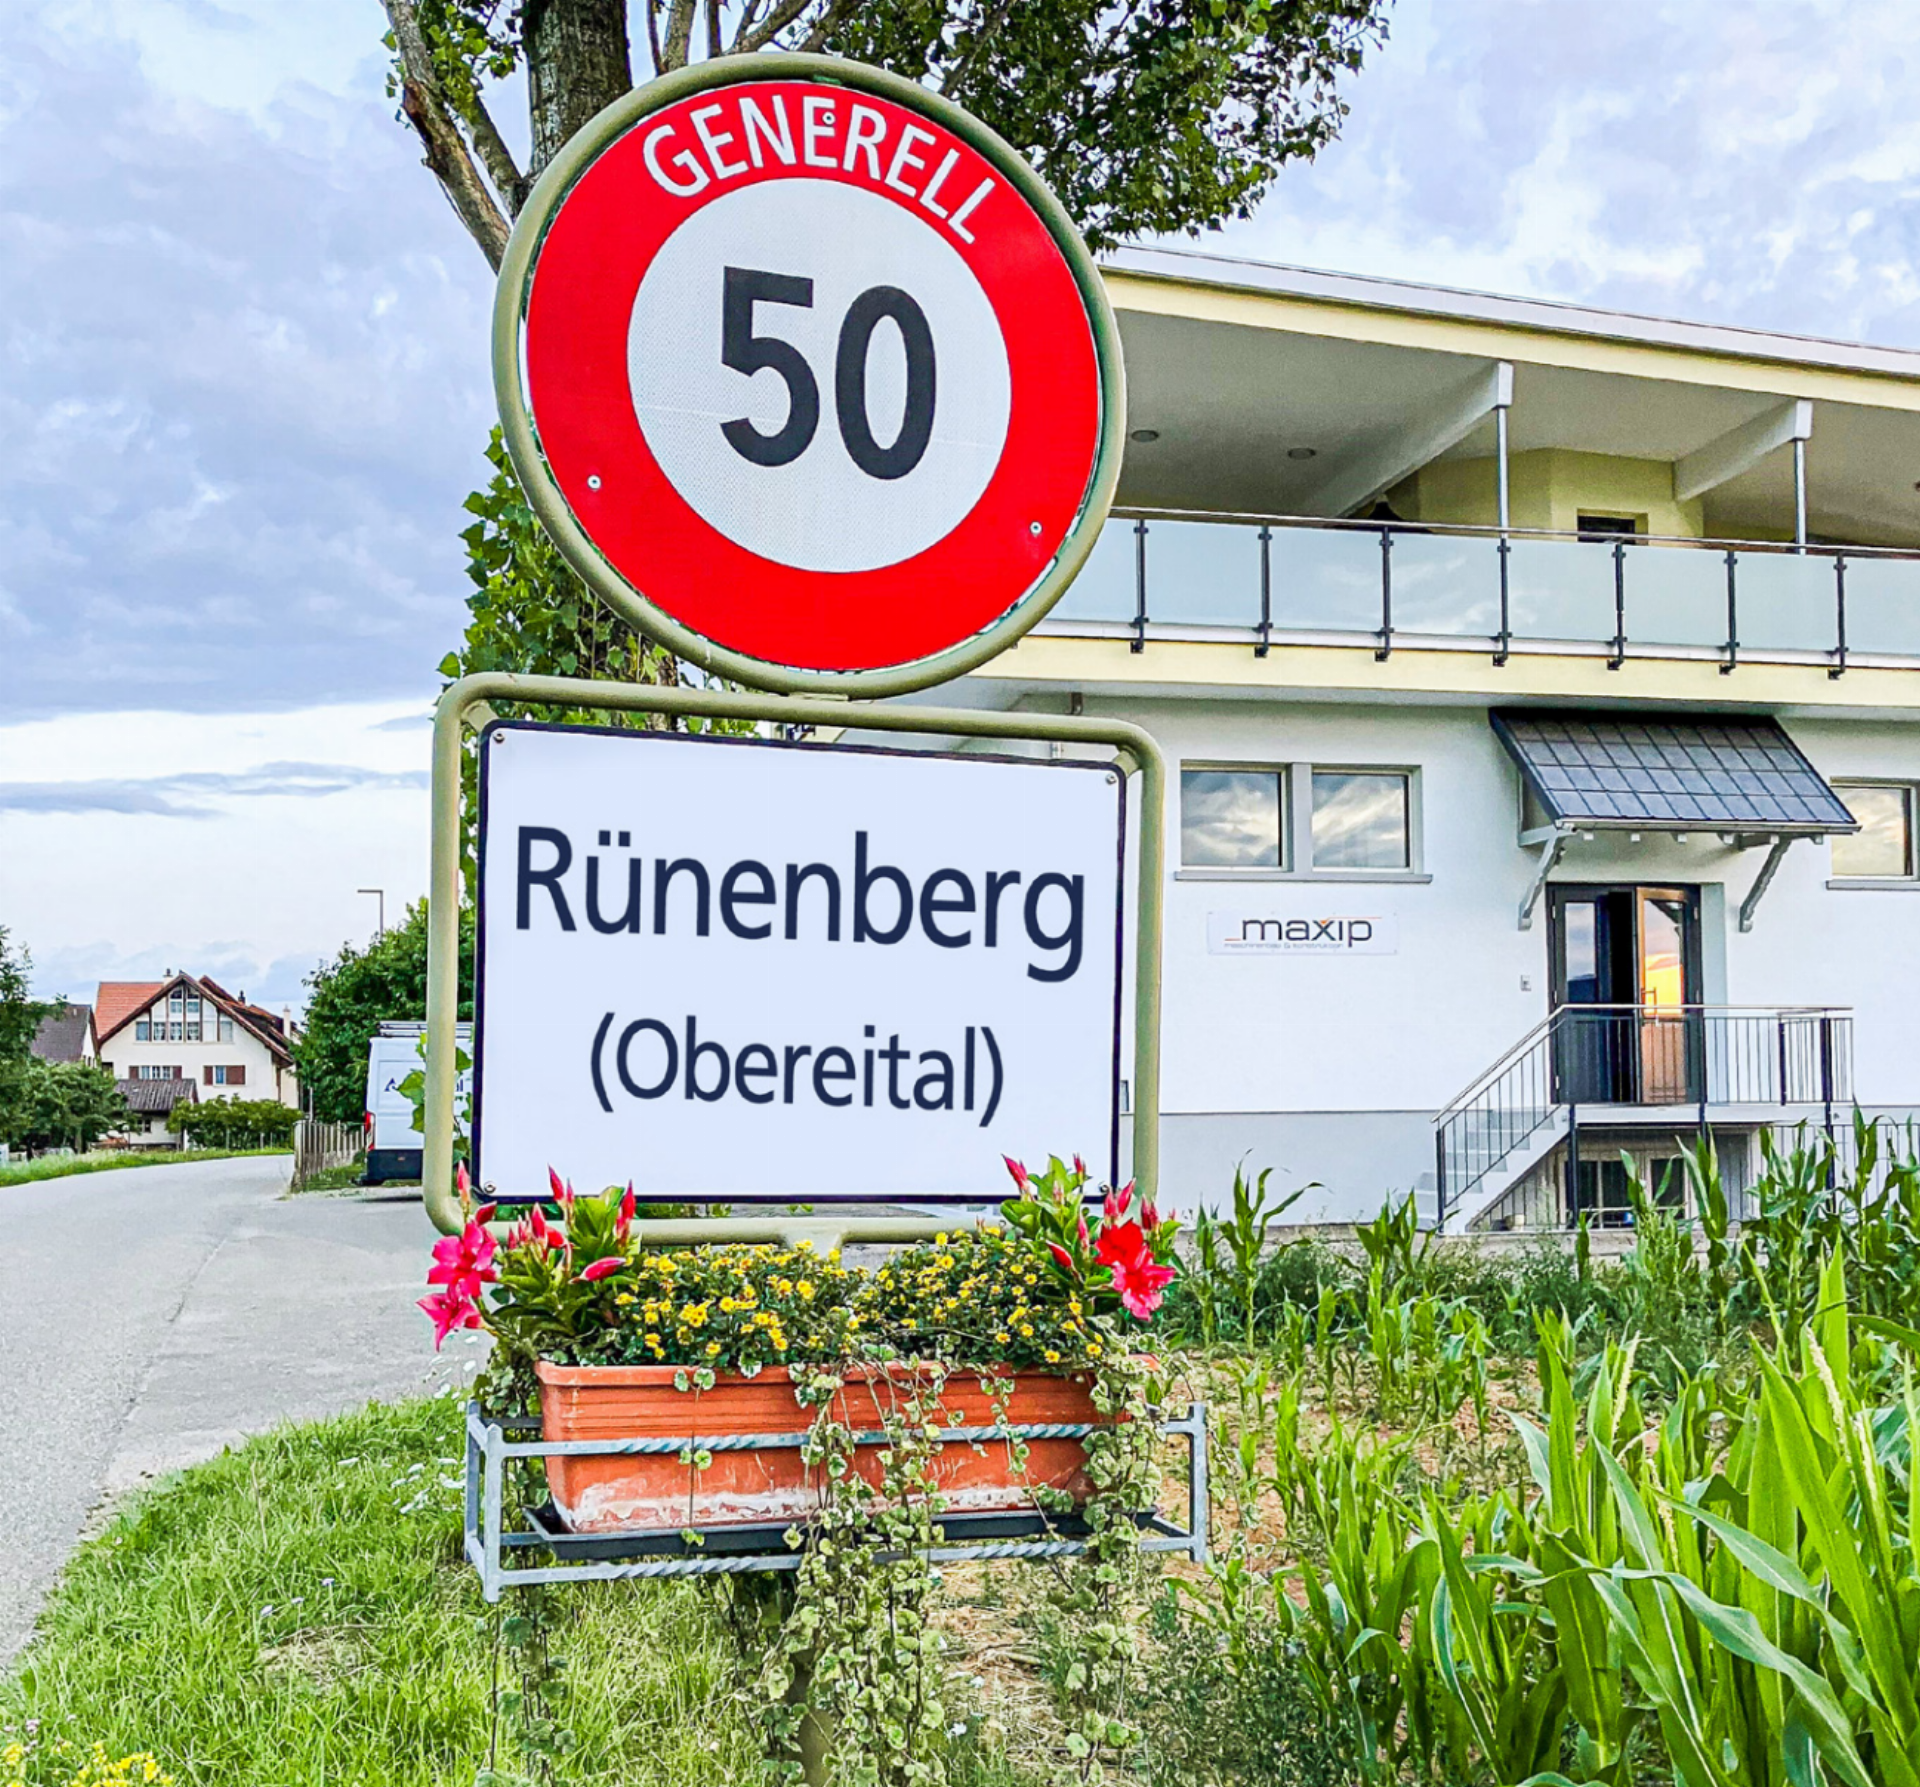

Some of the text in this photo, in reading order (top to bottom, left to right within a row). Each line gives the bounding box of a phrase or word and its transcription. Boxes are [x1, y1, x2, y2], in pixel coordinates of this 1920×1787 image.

[642, 94, 996, 245] GENERELL
[720, 265, 937, 480] 50
[516, 825, 1085, 983] Rünenberg
[1242, 919, 1373, 948] maxip
[590, 1012, 1004, 1128] (Obereital)
